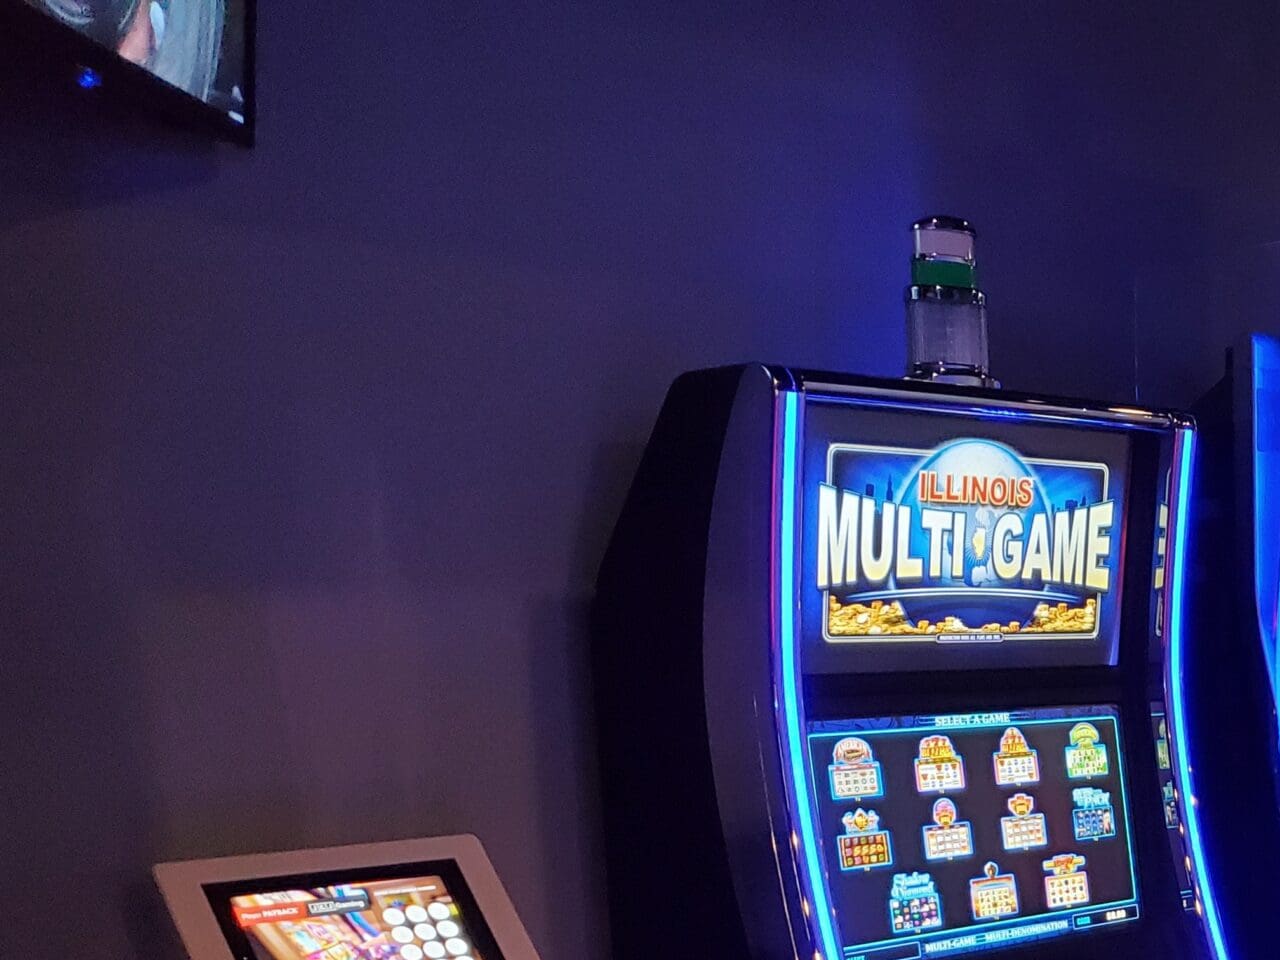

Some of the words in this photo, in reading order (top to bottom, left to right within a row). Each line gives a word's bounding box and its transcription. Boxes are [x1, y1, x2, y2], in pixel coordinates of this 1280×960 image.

[918, 470, 1035, 508] ILLINOIS
[817, 482, 967, 591] MULTI
[991, 500, 1116, 593] GAME
[935, 714, 971, 726] SELECT
[983, 712, 1010, 724] GAME
